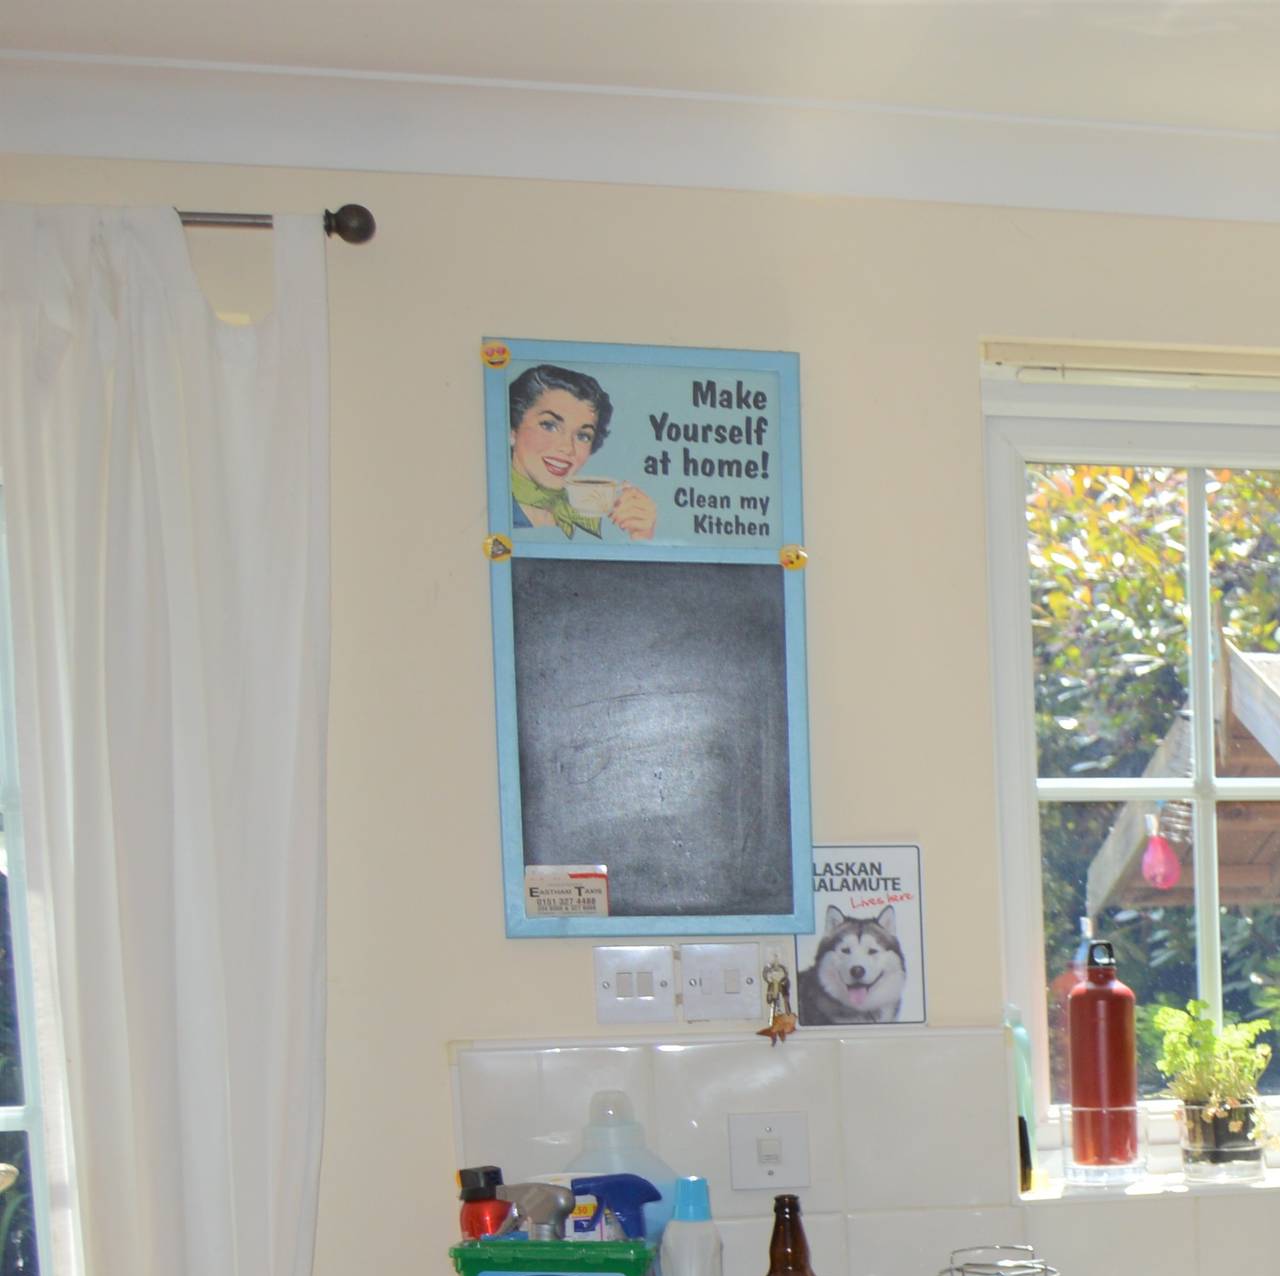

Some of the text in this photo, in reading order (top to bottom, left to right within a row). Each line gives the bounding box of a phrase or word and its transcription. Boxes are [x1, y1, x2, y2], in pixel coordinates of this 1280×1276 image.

[692, 380, 767, 410] Make
[649, 412, 768, 445] Yourself
[644, 447, 769, 479] at home!
[674, 487, 770, 516] Clean my
[694, 514, 770, 536] Kitchen
[812, 862, 882, 877] LASKAN
